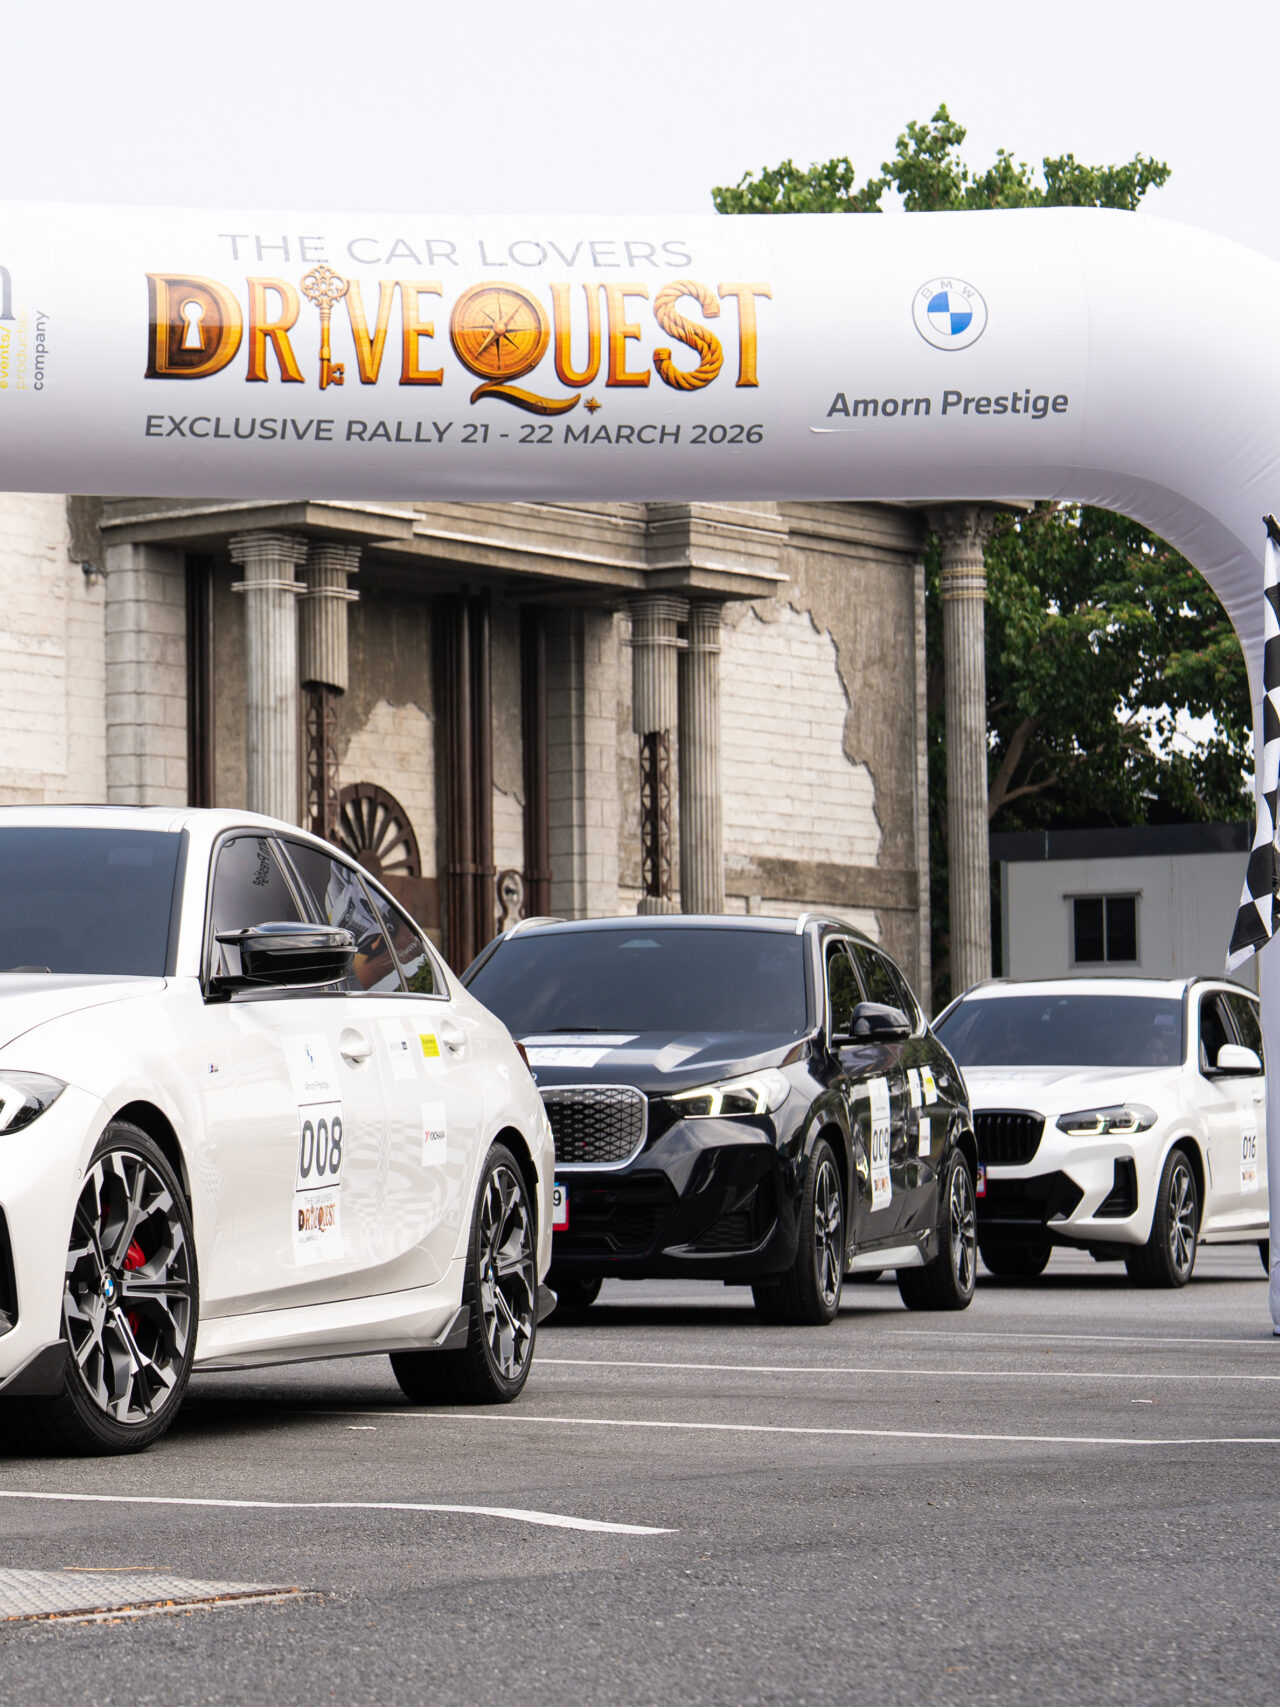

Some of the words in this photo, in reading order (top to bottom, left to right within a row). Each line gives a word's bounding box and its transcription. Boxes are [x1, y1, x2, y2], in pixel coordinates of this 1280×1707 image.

[218, 234, 330, 264] THE
[347, 238, 460, 266] CAR
[478, 240, 694, 268] LOVERS
[920, 280, 976, 300] BMW
[33, 309, 50, 391] company
[826, 392, 932, 417] Amorn
[941, 388, 1069, 420] Prestige
[144, 414, 335, 441] EXCLUSIVE
[345, 419, 455, 443] RALLY
[460, 423, 490, 444] 21
[518, 423, 554, 444] 22
[563, 424, 682, 445] MARCH
[689, 424, 765, 444] 2026
[299, 1115, 343, 1180] 008
[872, 1127, 889, 1163] 009
[1242, 1135, 1257, 1160] 016
